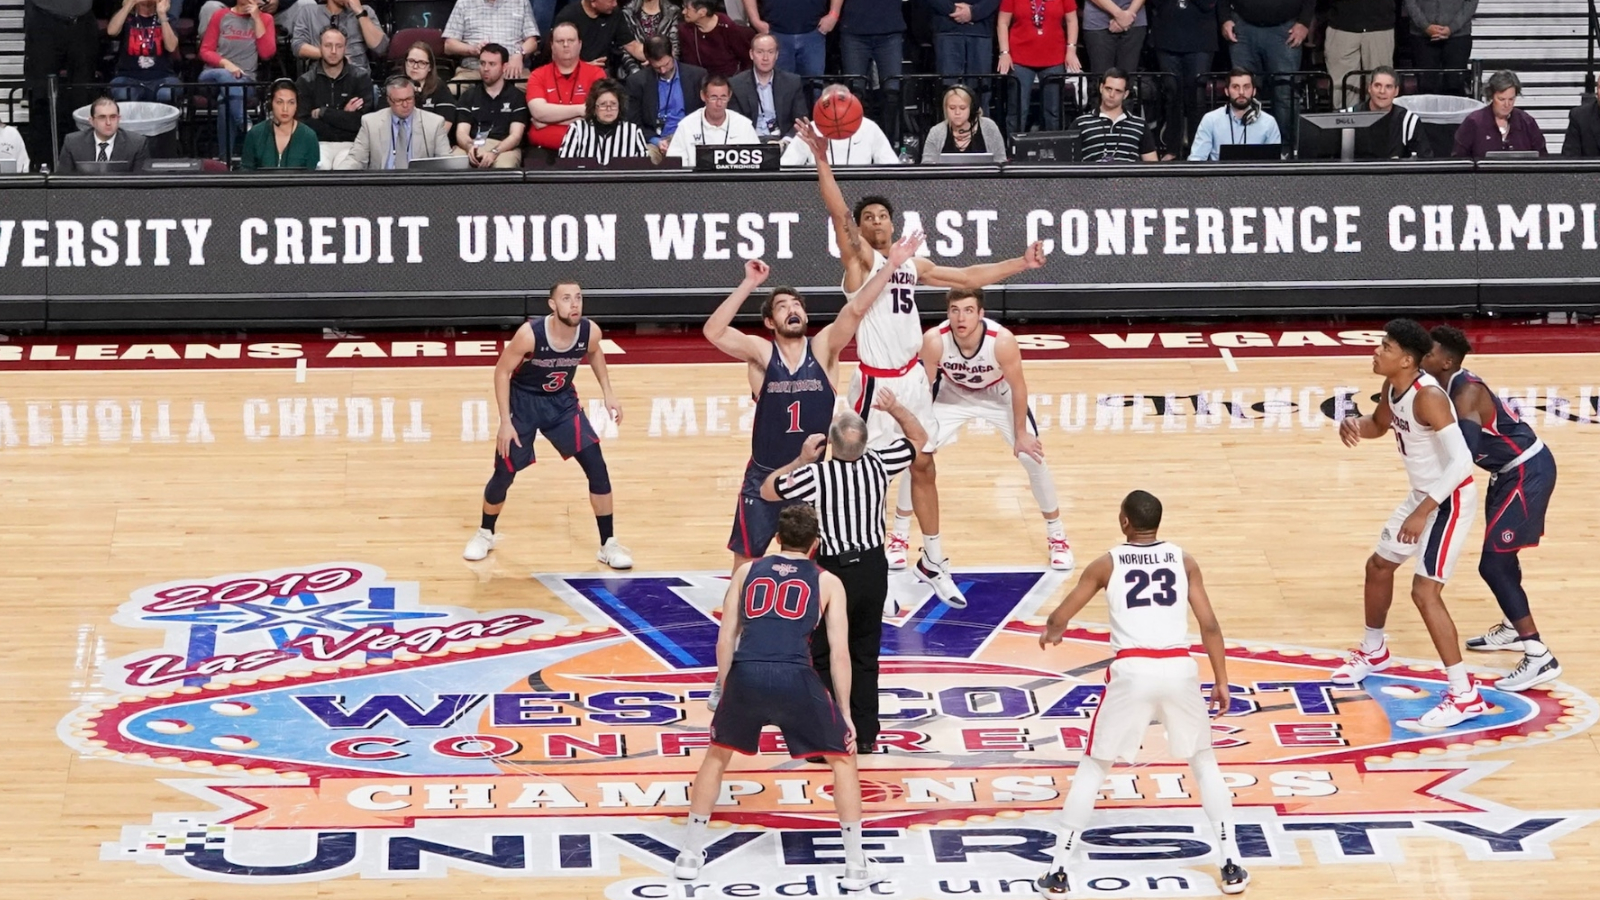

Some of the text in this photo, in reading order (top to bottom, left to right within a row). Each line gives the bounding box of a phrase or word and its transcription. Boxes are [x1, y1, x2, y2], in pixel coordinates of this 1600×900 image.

[714, 149, 763, 165] POSS
[239, 215, 430, 265] CREDIT
[457, 213, 617, 263] UNION
[644, 211, 800, 260] WEST
[1026, 206, 1363, 257] CONFERENCE
[1388, 203, 1599, 252] CHAMPI
[890, 287, 913, 315] 15
[1089, 330, 1389, 350] VEGAS
[542, 371, 568, 392] 3
[785, 400, 805, 433] 1
[1119, 552, 1177, 565] NORVELL JR.
[144, 568, 362, 612] 2019
[745, 577, 811, 619] 00
[1124, 567, 1177, 609] 23
[127, 614, 544, 687] Las Vegas
[180, 817, 1567, 877] UNIVERSITY
[939, 874, 1190, 894] unon
